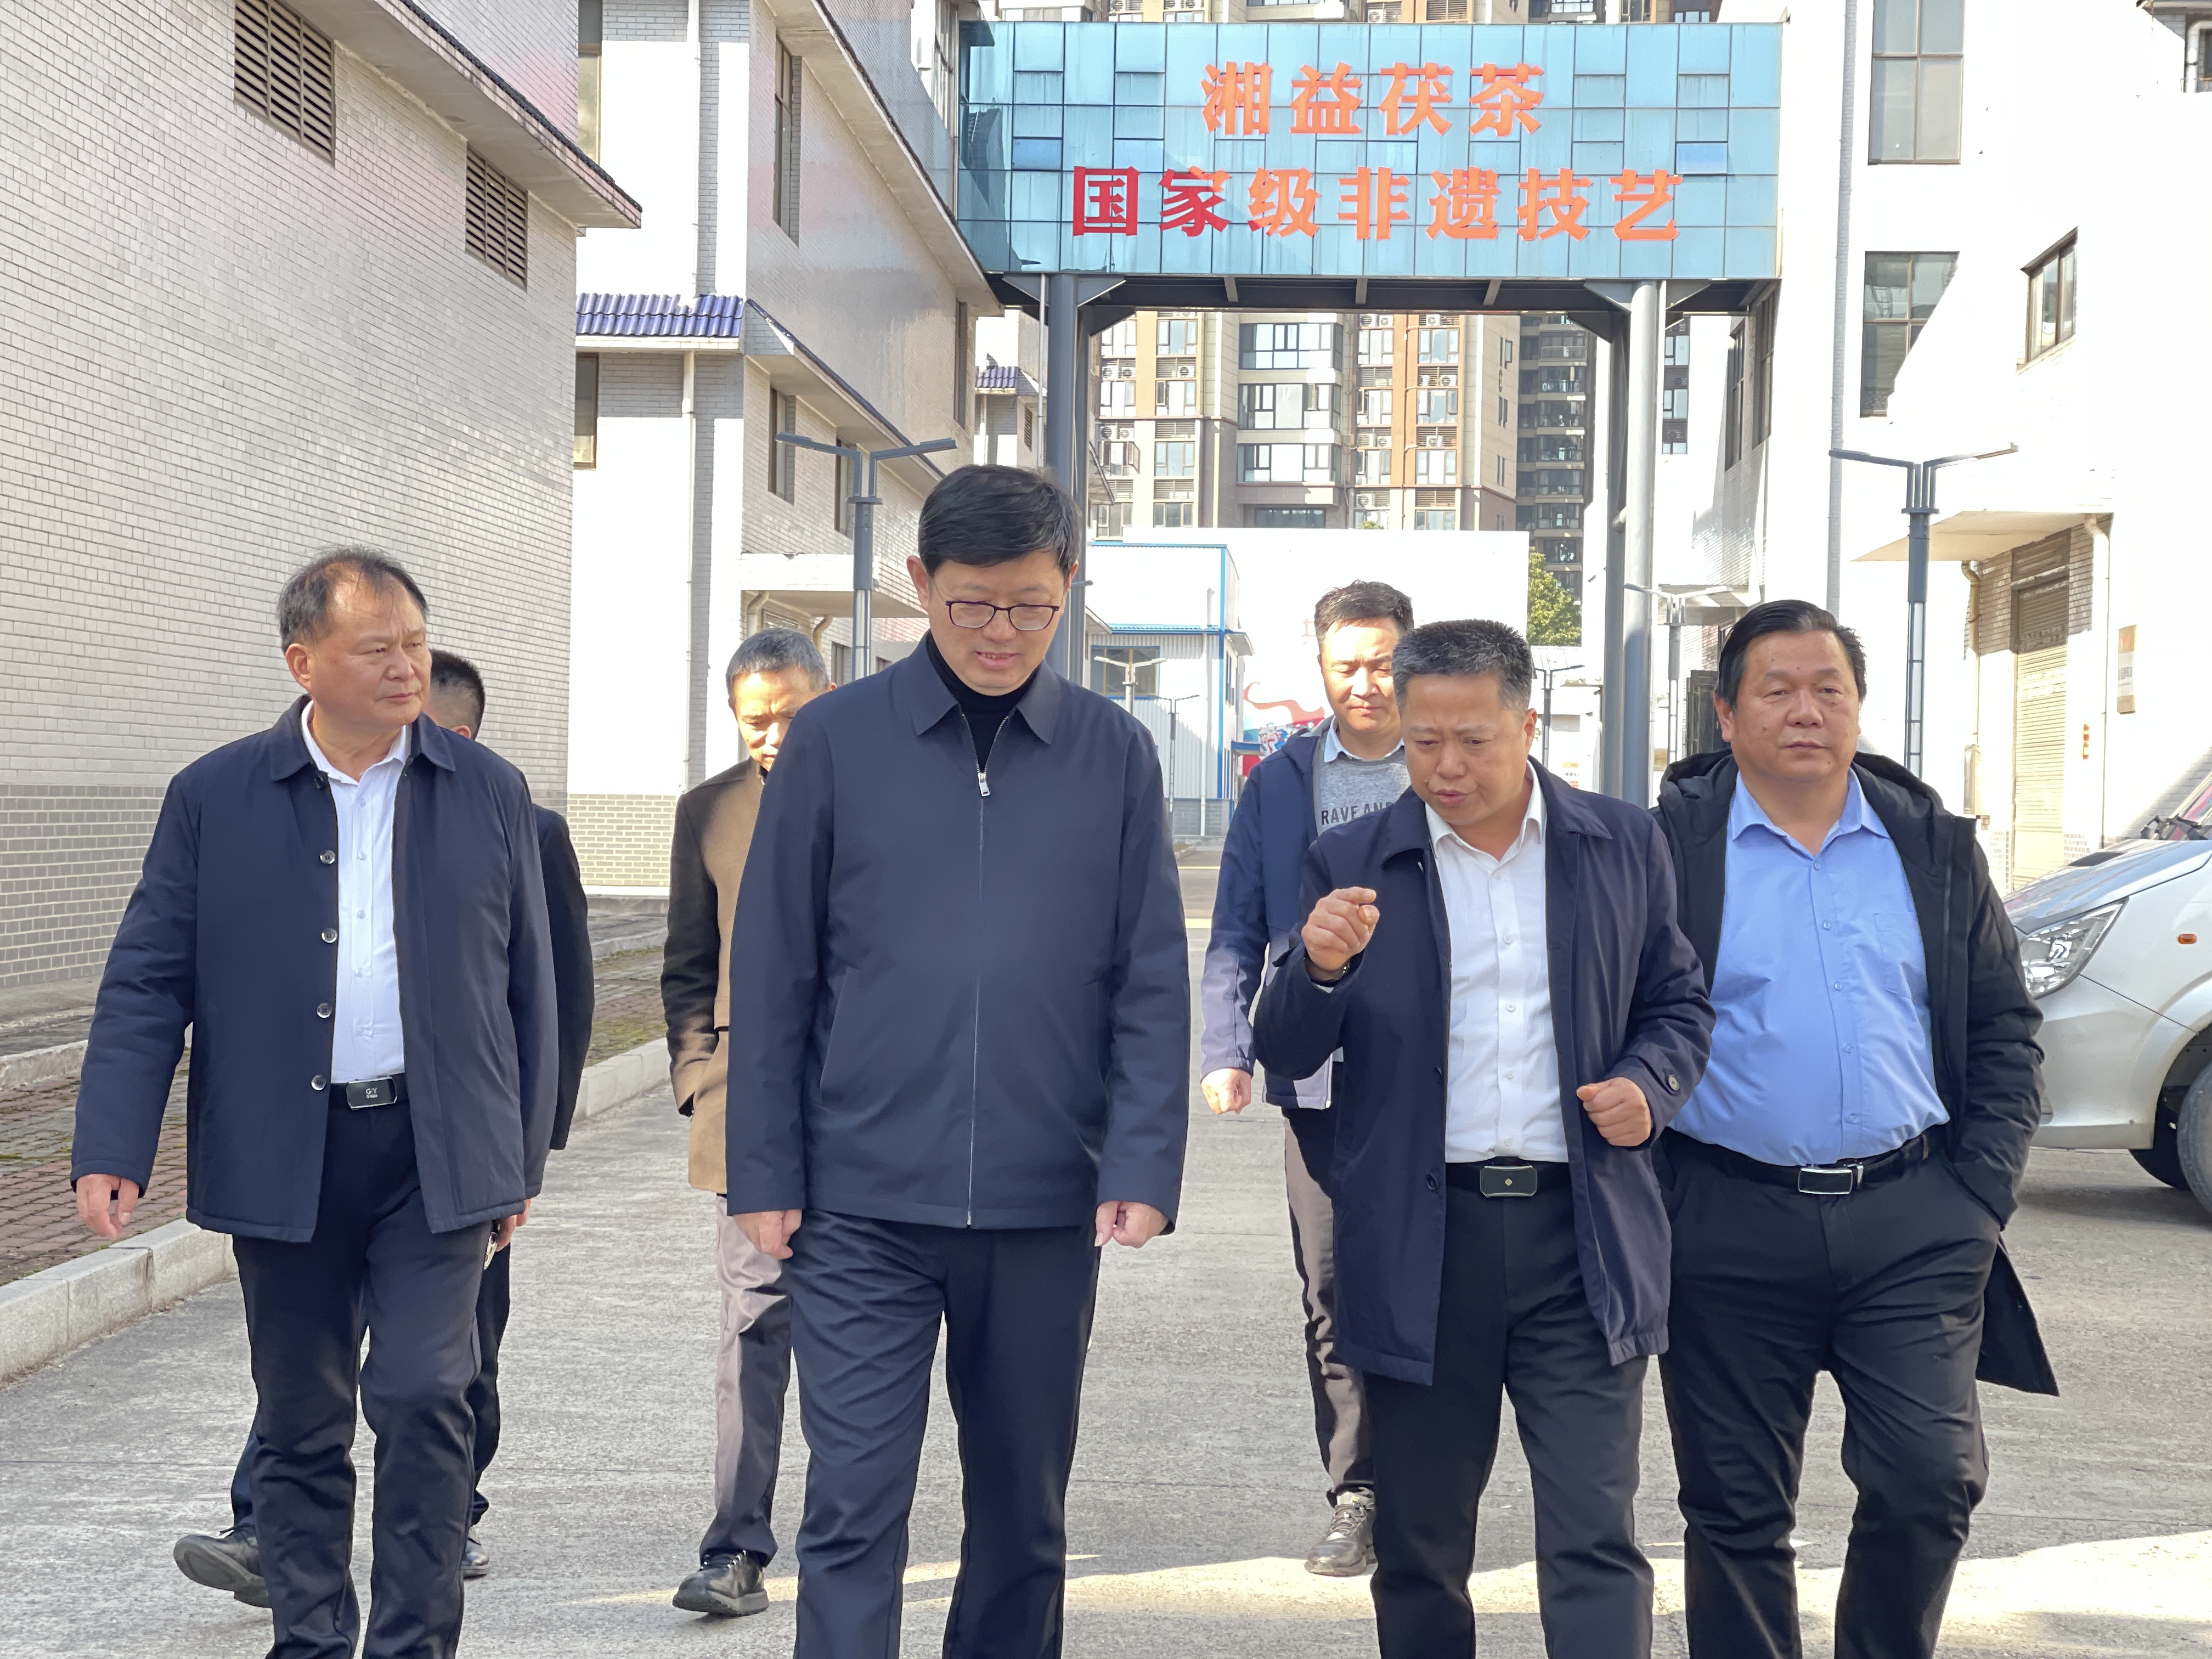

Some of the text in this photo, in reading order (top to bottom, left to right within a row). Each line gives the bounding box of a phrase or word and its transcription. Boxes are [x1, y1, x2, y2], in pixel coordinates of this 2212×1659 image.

[1200, 61, 1544, 136] 湘益茯茶
[1073, 166, 1684, 241] 国家级非遗技艺
